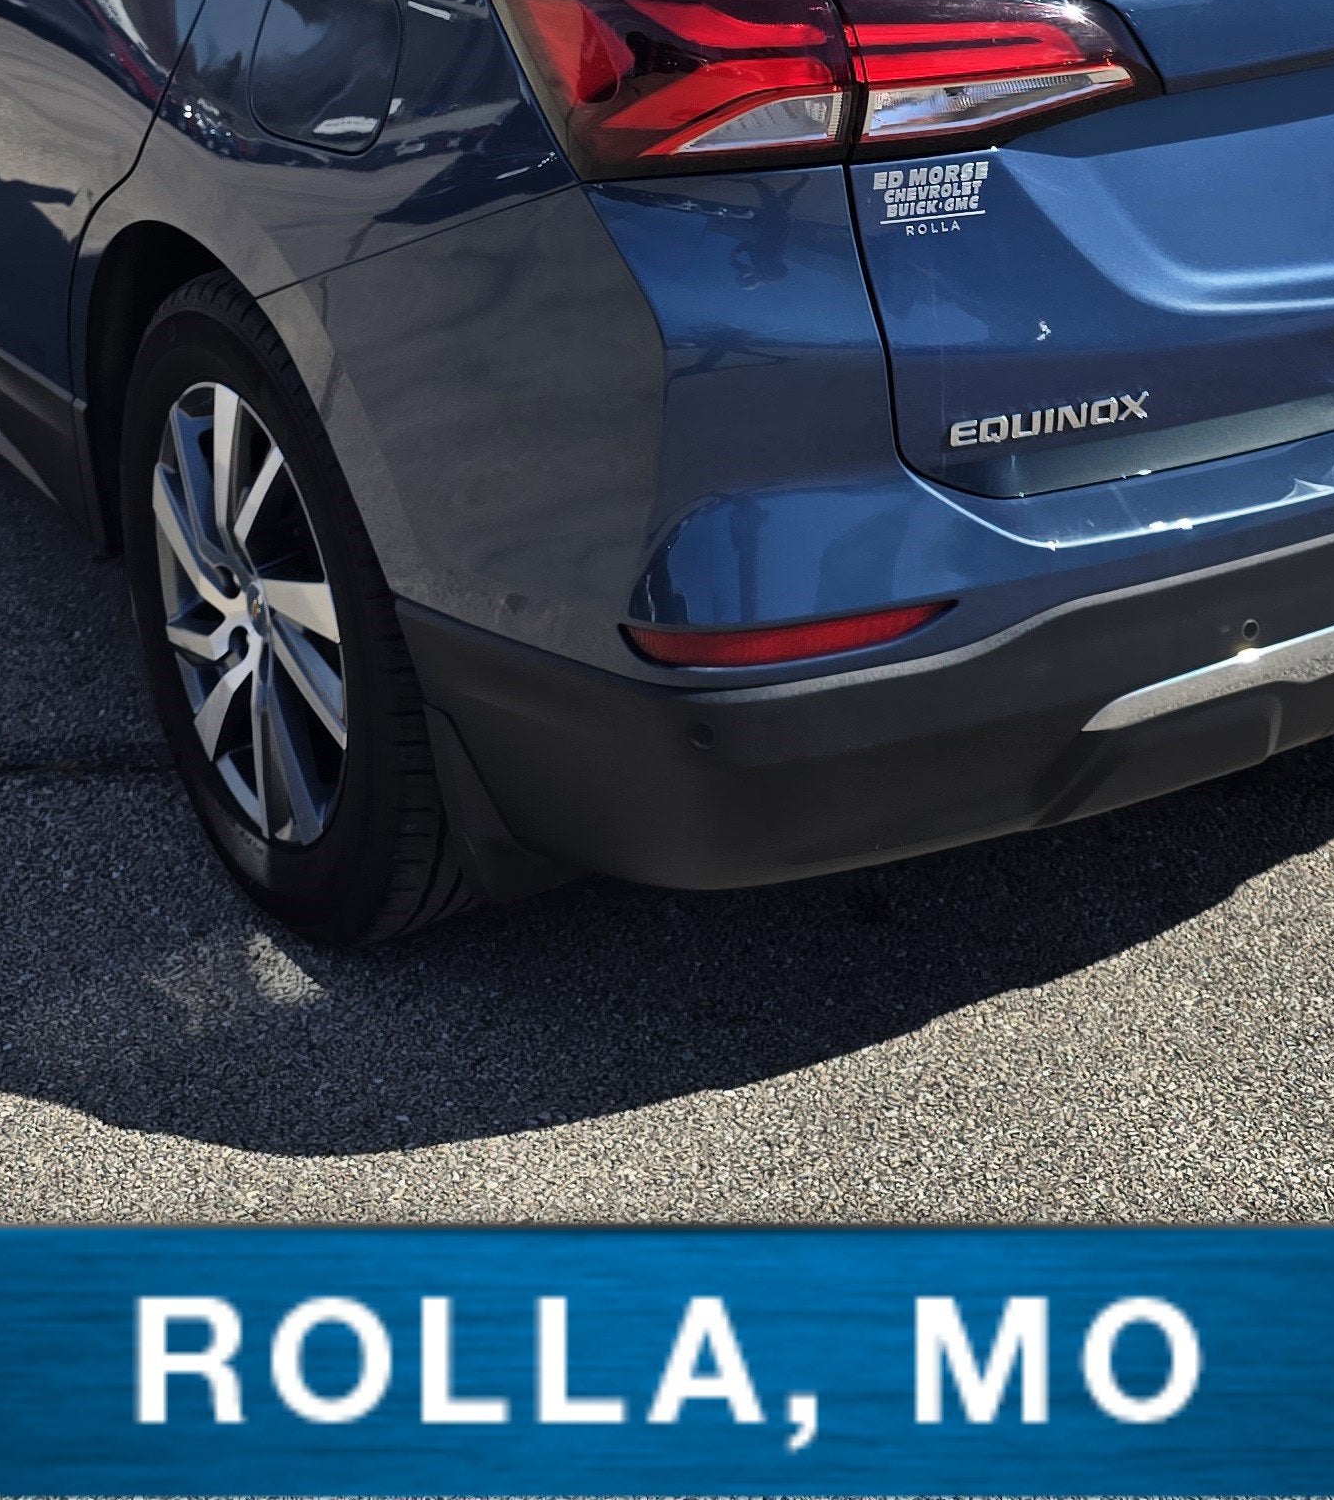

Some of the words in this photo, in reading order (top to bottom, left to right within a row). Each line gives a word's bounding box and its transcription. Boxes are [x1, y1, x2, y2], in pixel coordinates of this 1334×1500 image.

[873, 171, 904, 191] ED
[908, 161, 989, 187] MORSE
[884, 180, 982, 204] CHEVROLET
[906, 220, 961, 236] ROLLA
[950, 390, 1149, 448] EQUINOX
